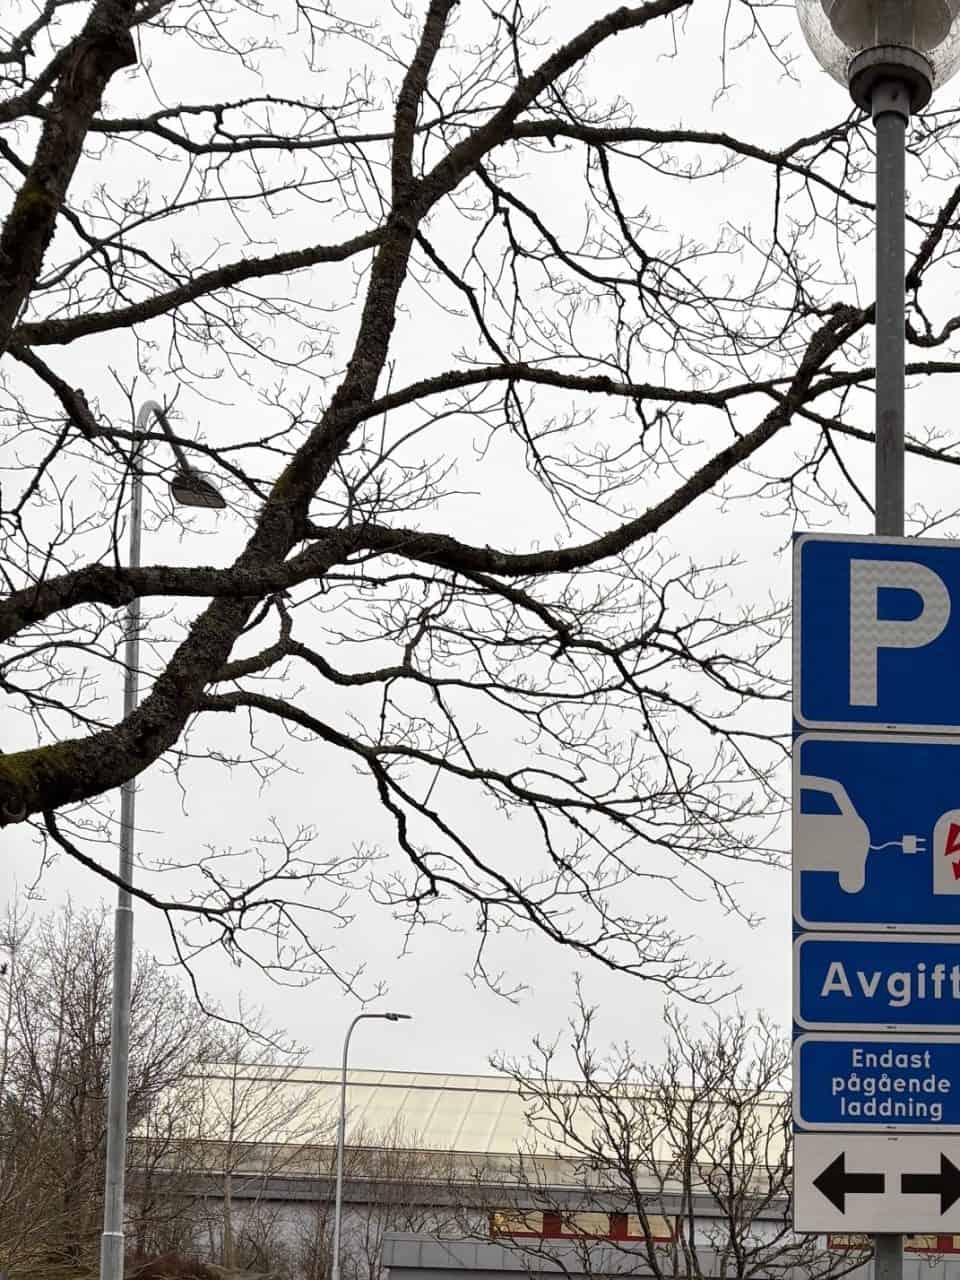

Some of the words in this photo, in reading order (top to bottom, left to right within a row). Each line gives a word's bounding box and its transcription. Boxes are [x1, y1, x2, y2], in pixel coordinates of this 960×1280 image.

[850, 558, 951, 707] P
[852, 1048, 932, 1069] Endast
[831, 1072, 951, 1097] pågående
[840, 1096, 943, 1122] laddning
